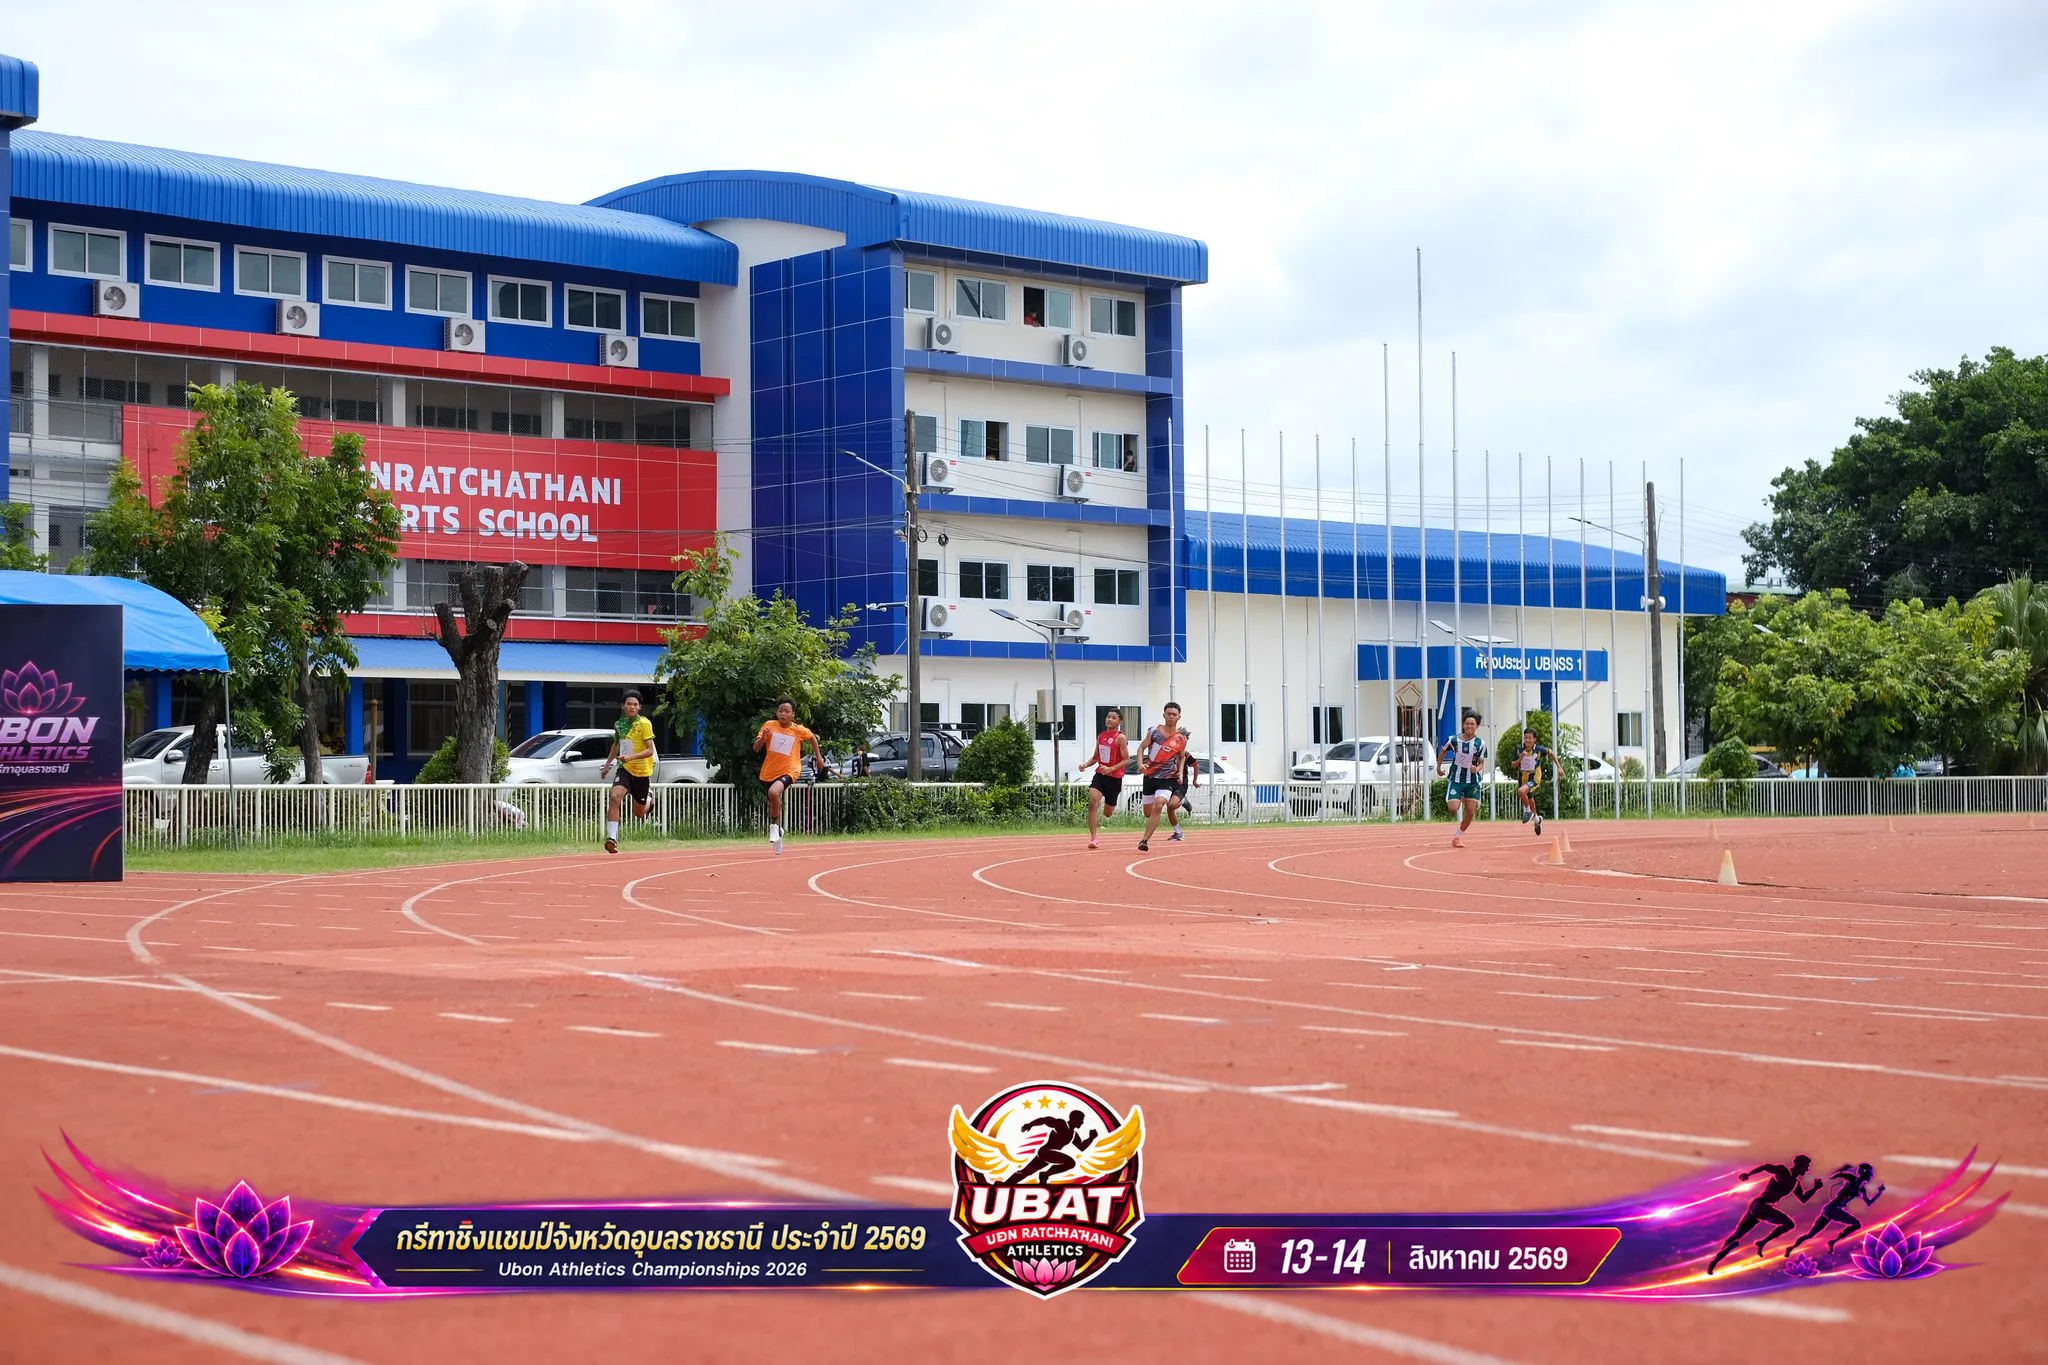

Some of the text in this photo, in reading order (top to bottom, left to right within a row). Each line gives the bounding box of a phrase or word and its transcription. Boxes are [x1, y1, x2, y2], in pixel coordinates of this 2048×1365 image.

[330, 459, 620, 505] NRATCHATHANI
[478, 507, 599, 543] SCHOOL
[0, 717, 100, 744] BON
[0, 745, 94, 760] HLETICS
